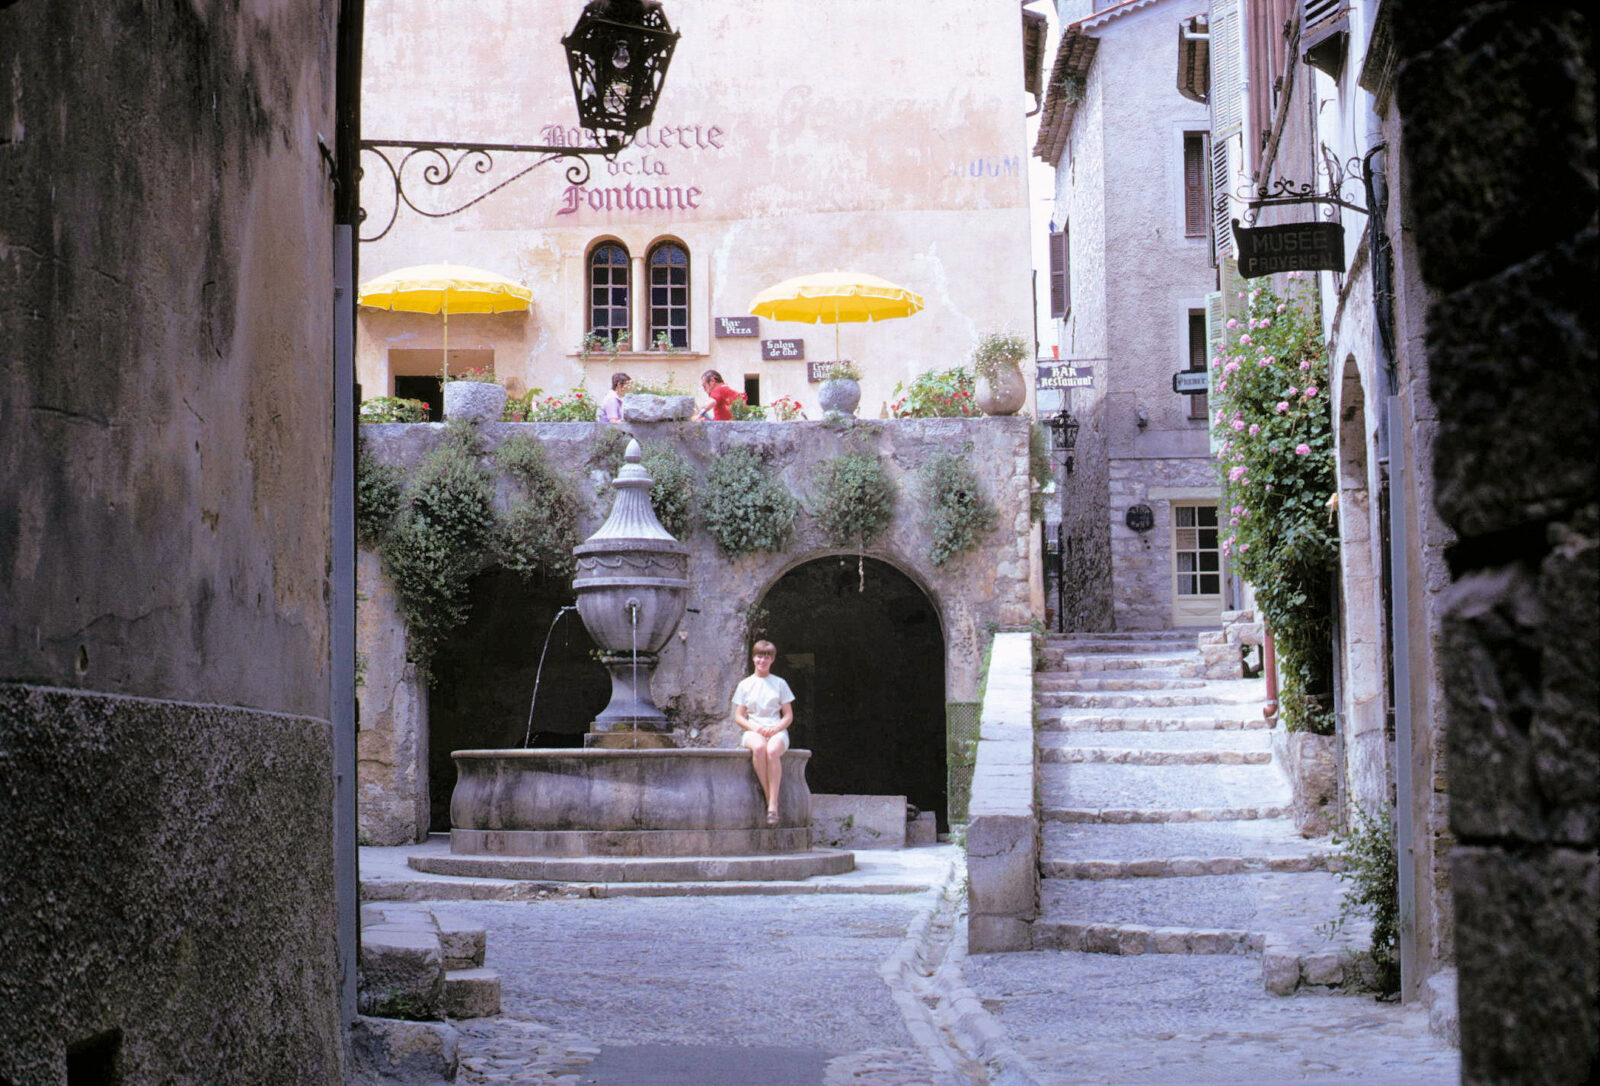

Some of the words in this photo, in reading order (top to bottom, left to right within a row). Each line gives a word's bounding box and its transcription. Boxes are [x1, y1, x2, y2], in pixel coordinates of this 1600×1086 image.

[556, 182, 702, 215] Fontaine
[721, 317, 741, 328] Bar
[726, 325, 752, 335] Pizza
[766, 341, 795, 350] Salon
[770, 348, 781, 357] de
[1052, 367, 1077, 377] BAR
[1041, 375, 1093, 388] Restaurant
